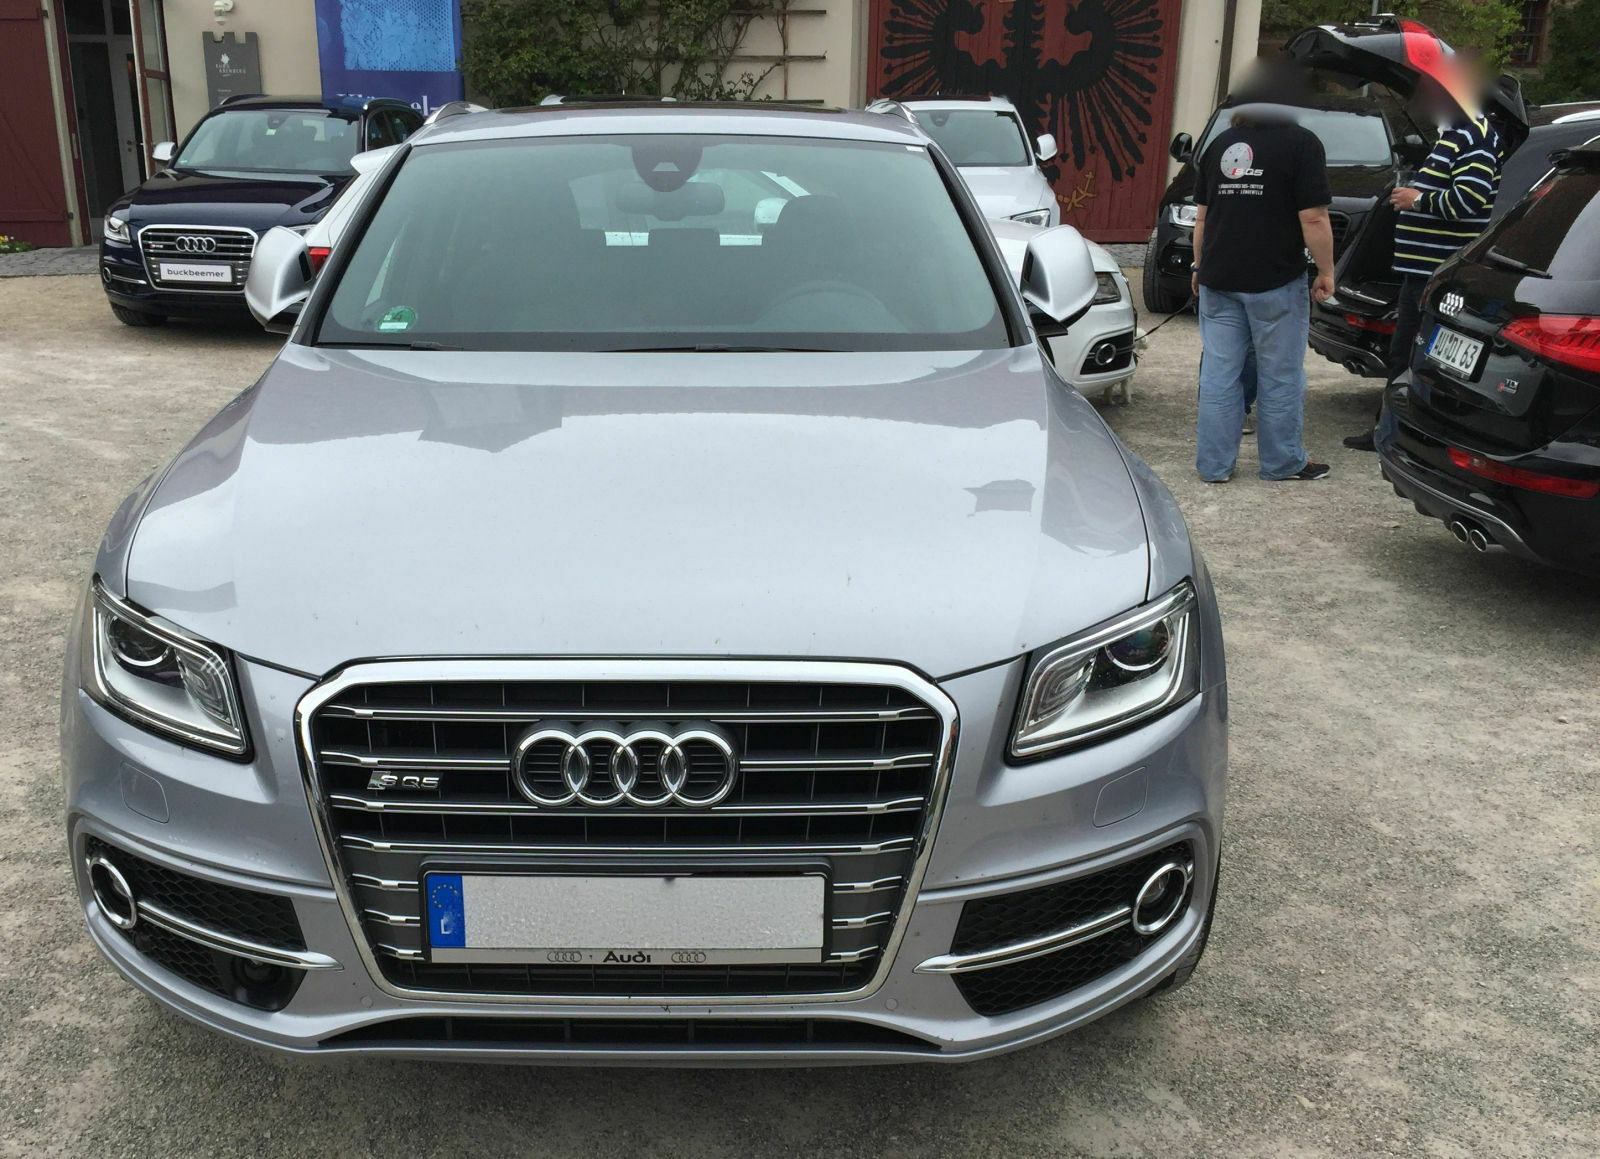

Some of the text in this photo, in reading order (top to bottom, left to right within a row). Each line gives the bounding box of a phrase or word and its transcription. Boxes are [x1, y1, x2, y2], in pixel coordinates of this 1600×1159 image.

[1233, 167, 1264, 177] SQ5
[167, 267, 225, 278] buckbeemer
[1460, 343, 1479, 370] 63
[378, 773, 440, 789] SQ5
[602, 950, 652, 964] Audi
